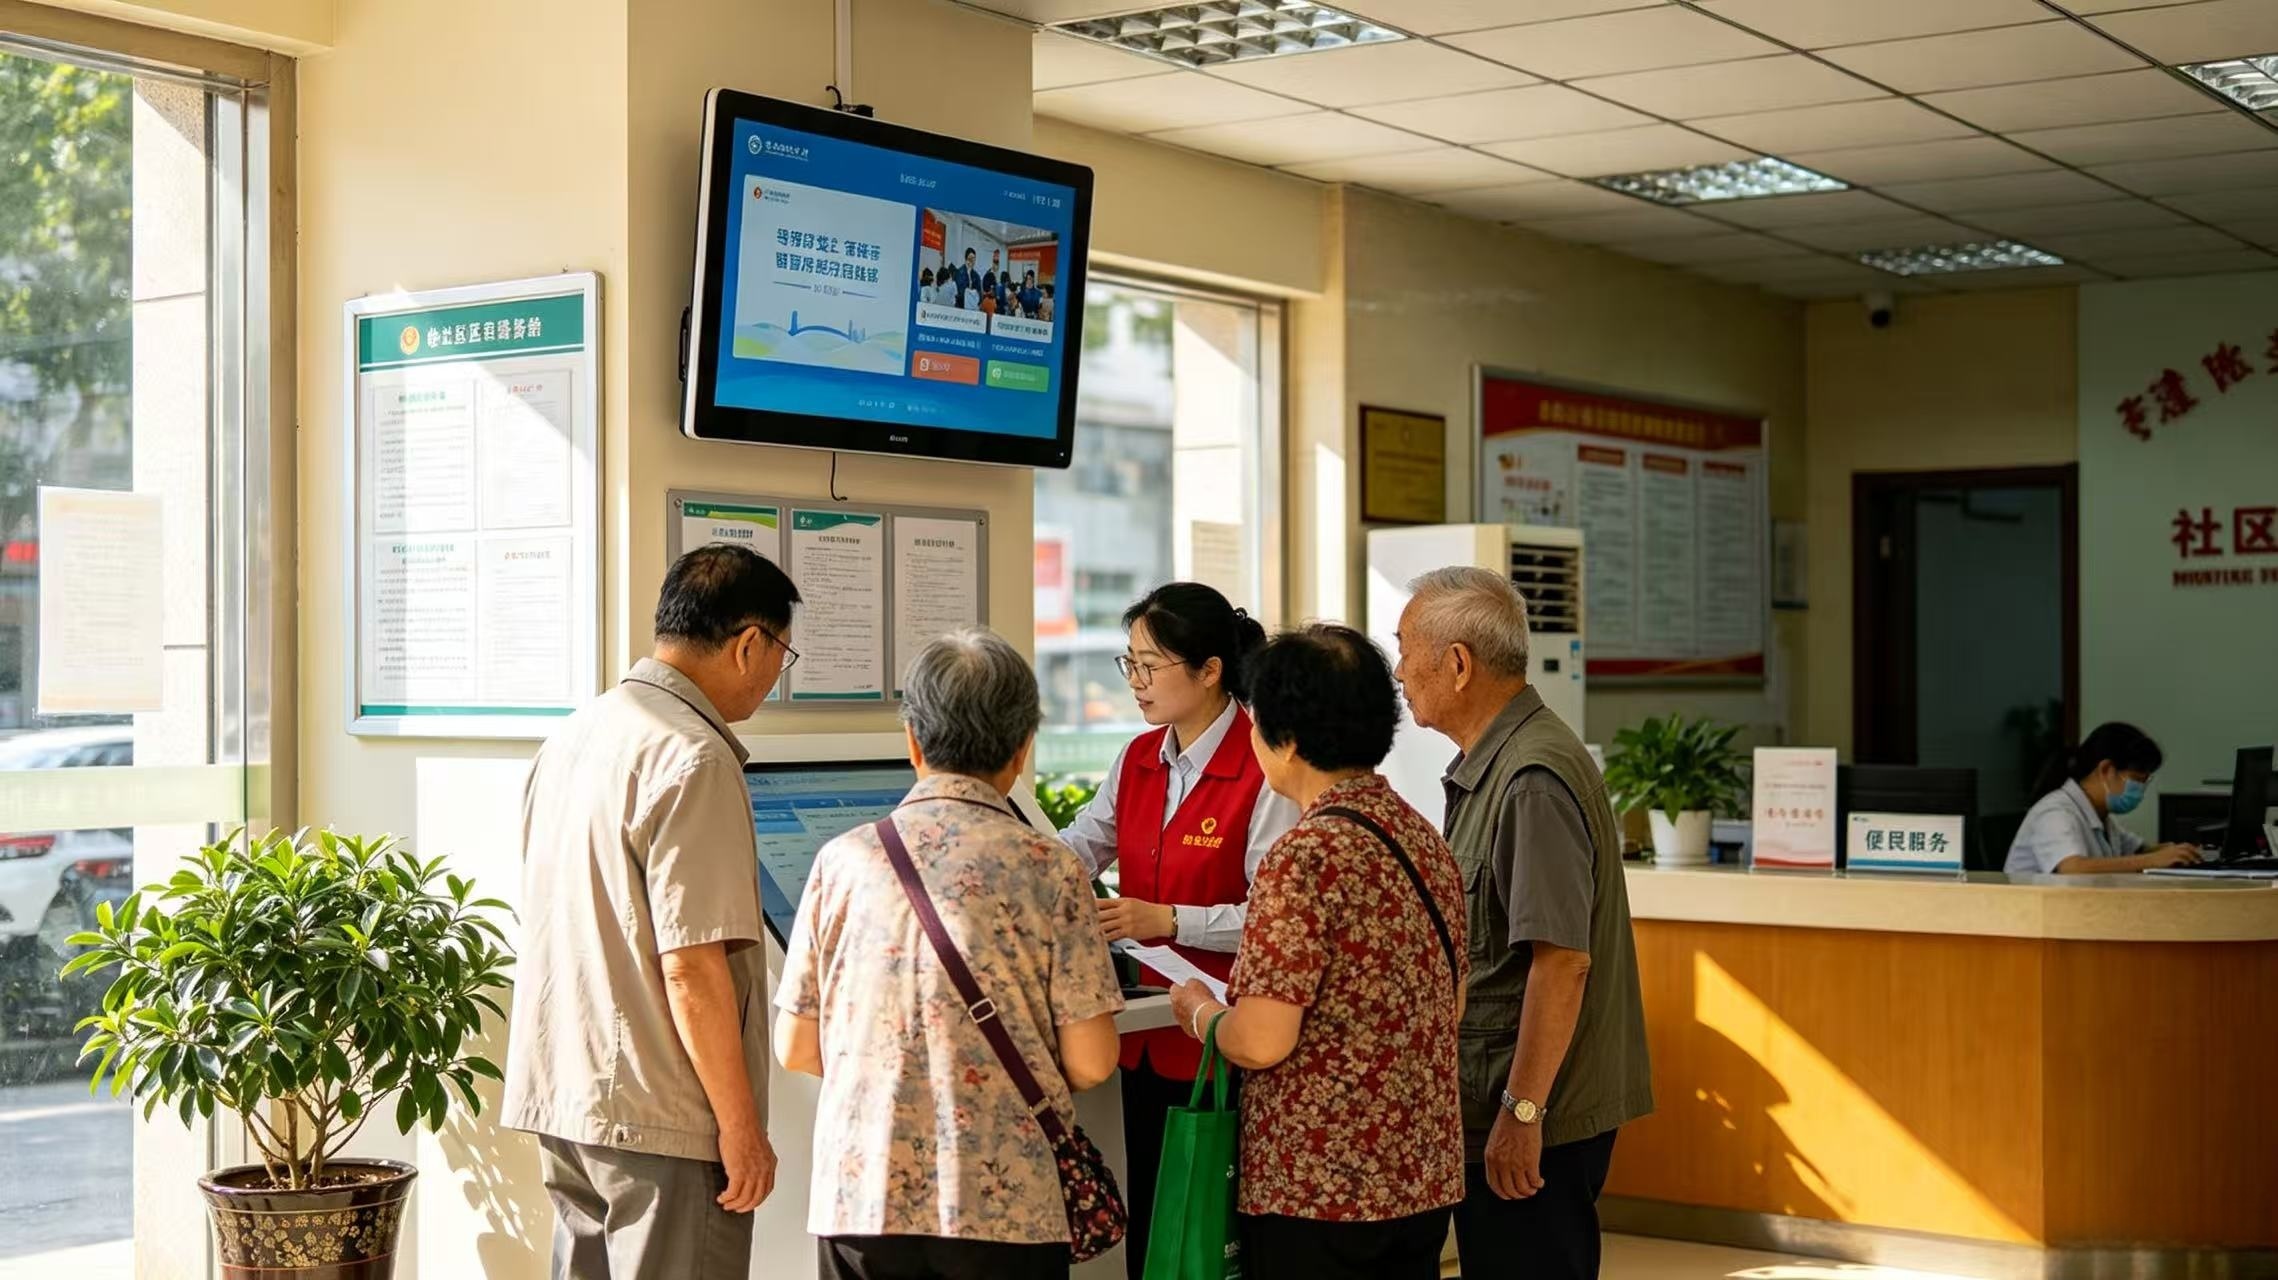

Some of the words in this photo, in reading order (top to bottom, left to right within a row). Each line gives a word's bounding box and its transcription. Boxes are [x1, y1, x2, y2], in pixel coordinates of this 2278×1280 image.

[2171, 507, 2278, 558] 社区
[1866, 829, 1949, 853] 便民服务
